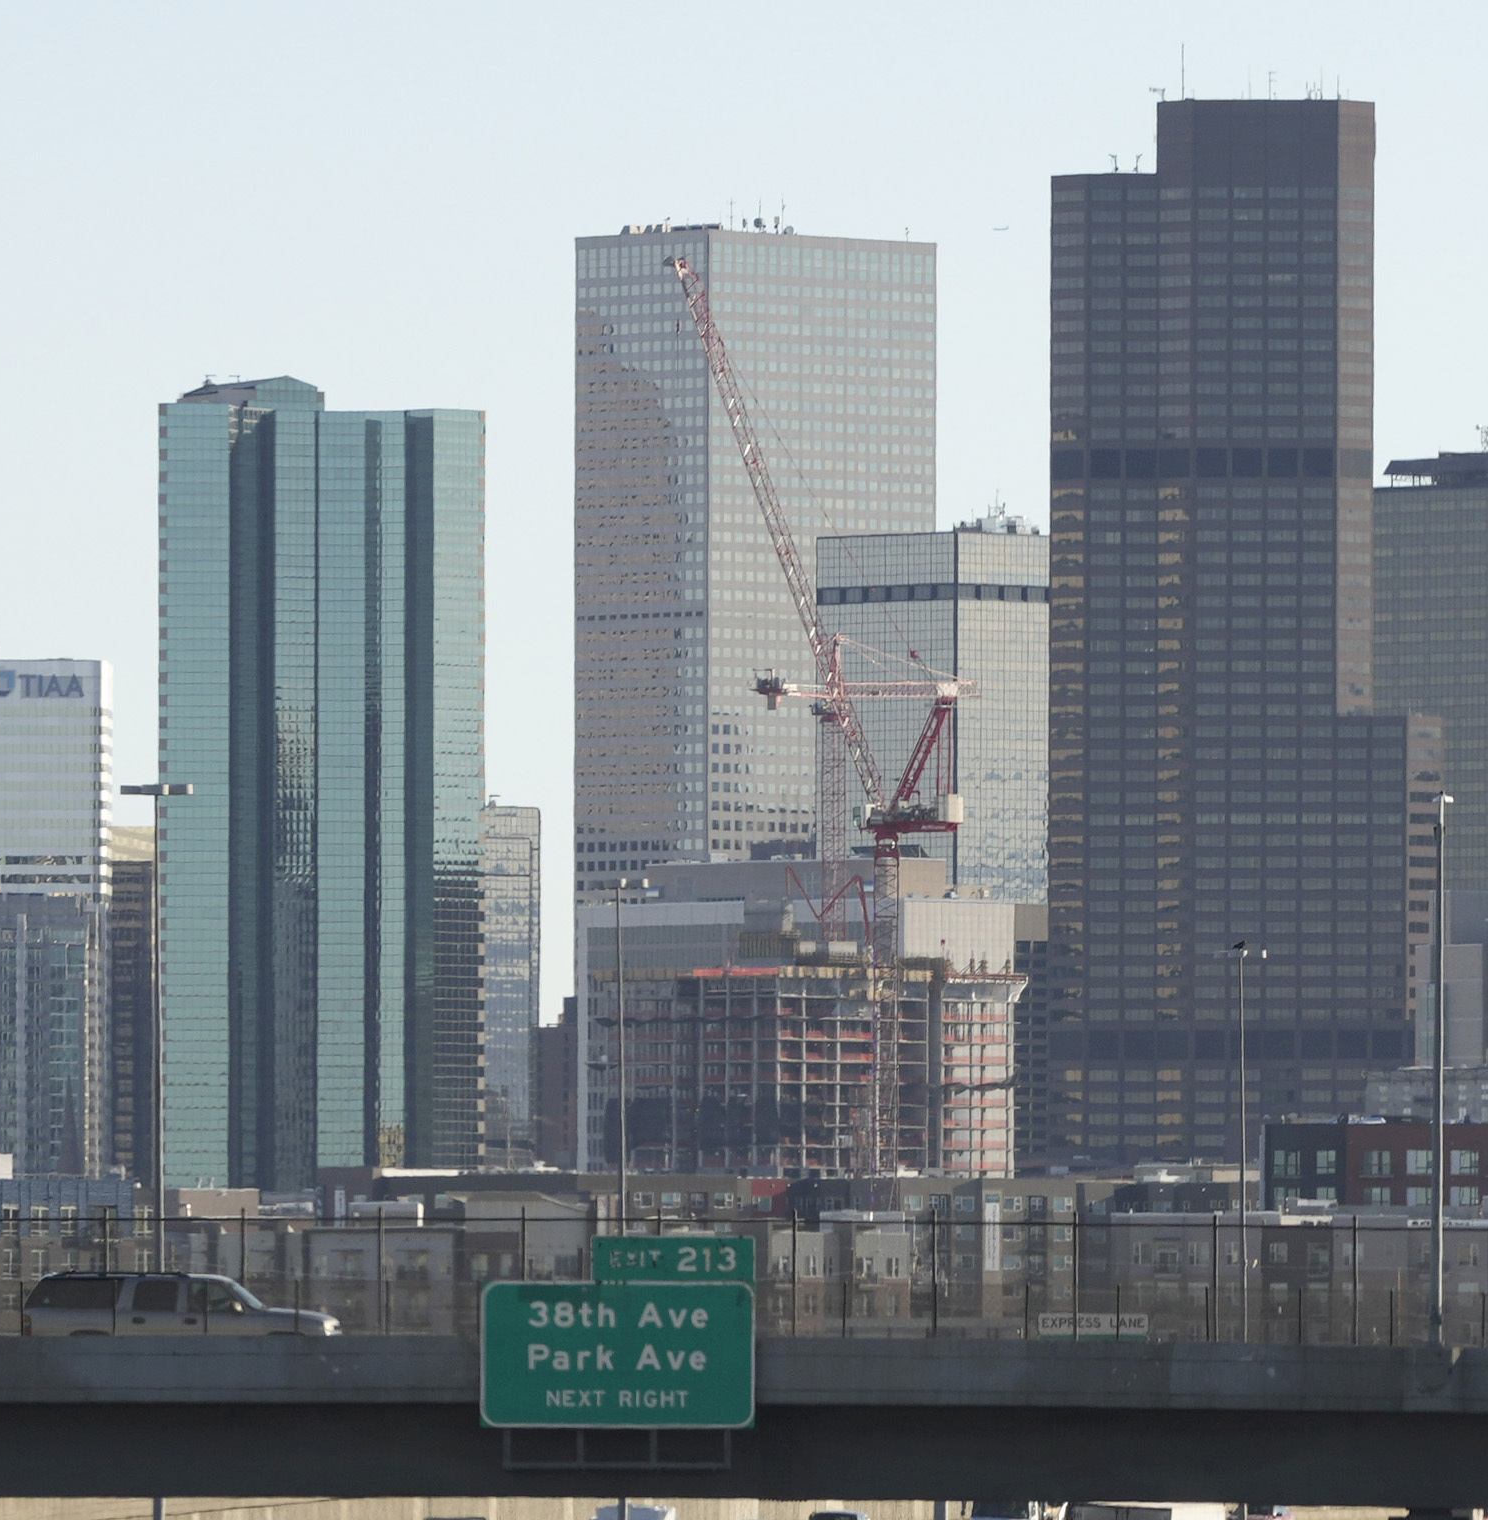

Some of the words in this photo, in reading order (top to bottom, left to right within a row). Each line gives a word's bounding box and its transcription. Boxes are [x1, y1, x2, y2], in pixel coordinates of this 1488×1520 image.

[18, 674, 84, 698] TIAA
[610, 1250, 661, 1267] EXIT
[678, 1247, 736, 1272] 213
[529, 1301, 615, 1327] 38th
[638, 1302, 708, 1328] Ave
[1041, 1317, 1101, 1329] EXPRESS
[1110, 1317, 1145, 1329] LANE
[528, 1344, 613, 1370] Park
[637, 1344, 706, 1370] Ave
[547, 1390, 605, 1407] NEXT
[619, 1390, 688, 1408] RIGHT
